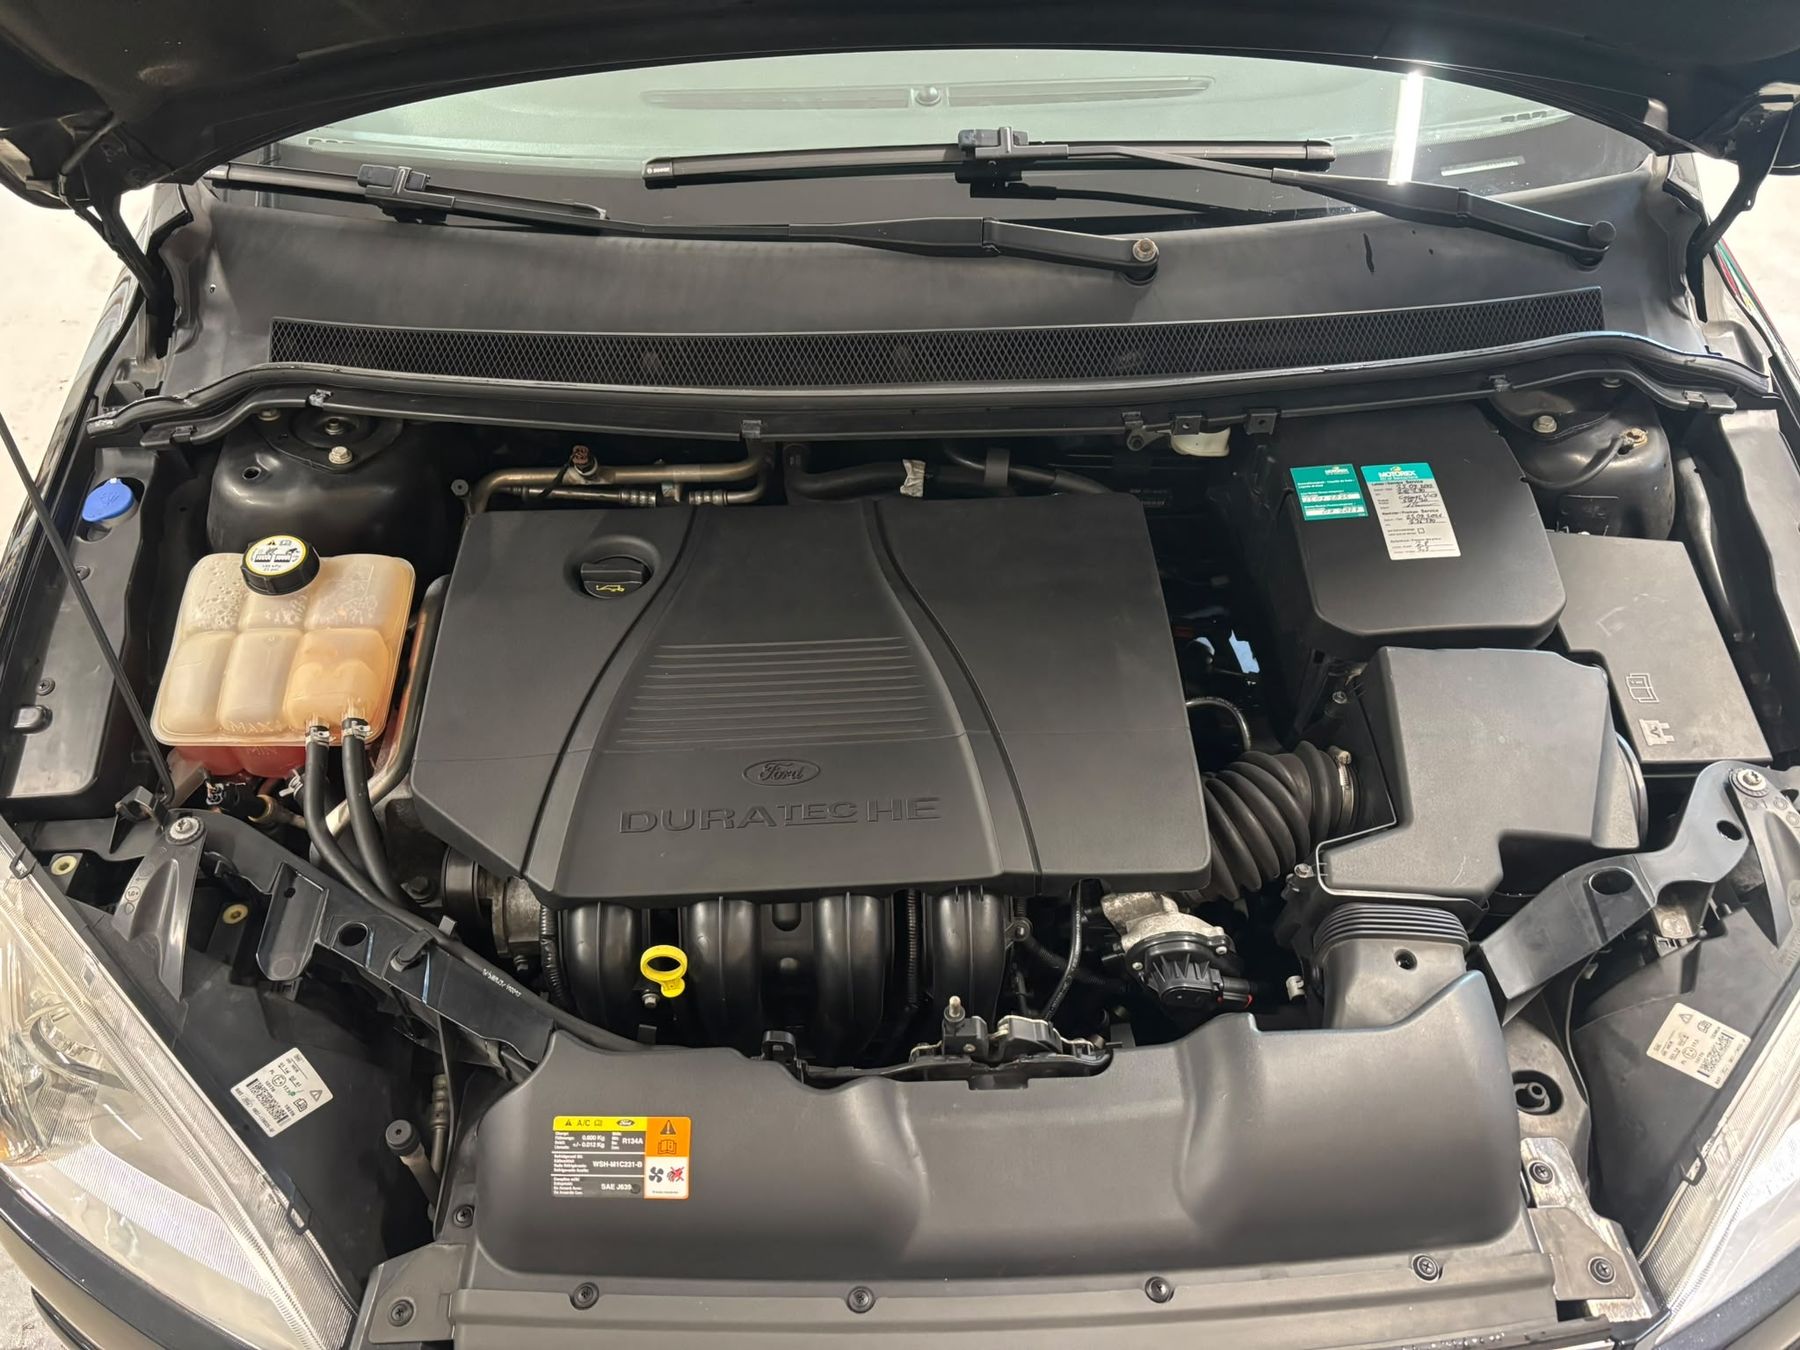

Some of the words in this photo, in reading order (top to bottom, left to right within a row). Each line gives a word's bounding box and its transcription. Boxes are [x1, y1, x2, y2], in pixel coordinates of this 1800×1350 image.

[759, 761, 804, 783] Ford
[618, 801, 858, 834] DURATEC
[865, 797, 941, 823] HE
[576, 1119, 591, 1127] A/C
[622, 1137, 644, 1145] R134A
[601, 1183, 616, 1191] SAE
